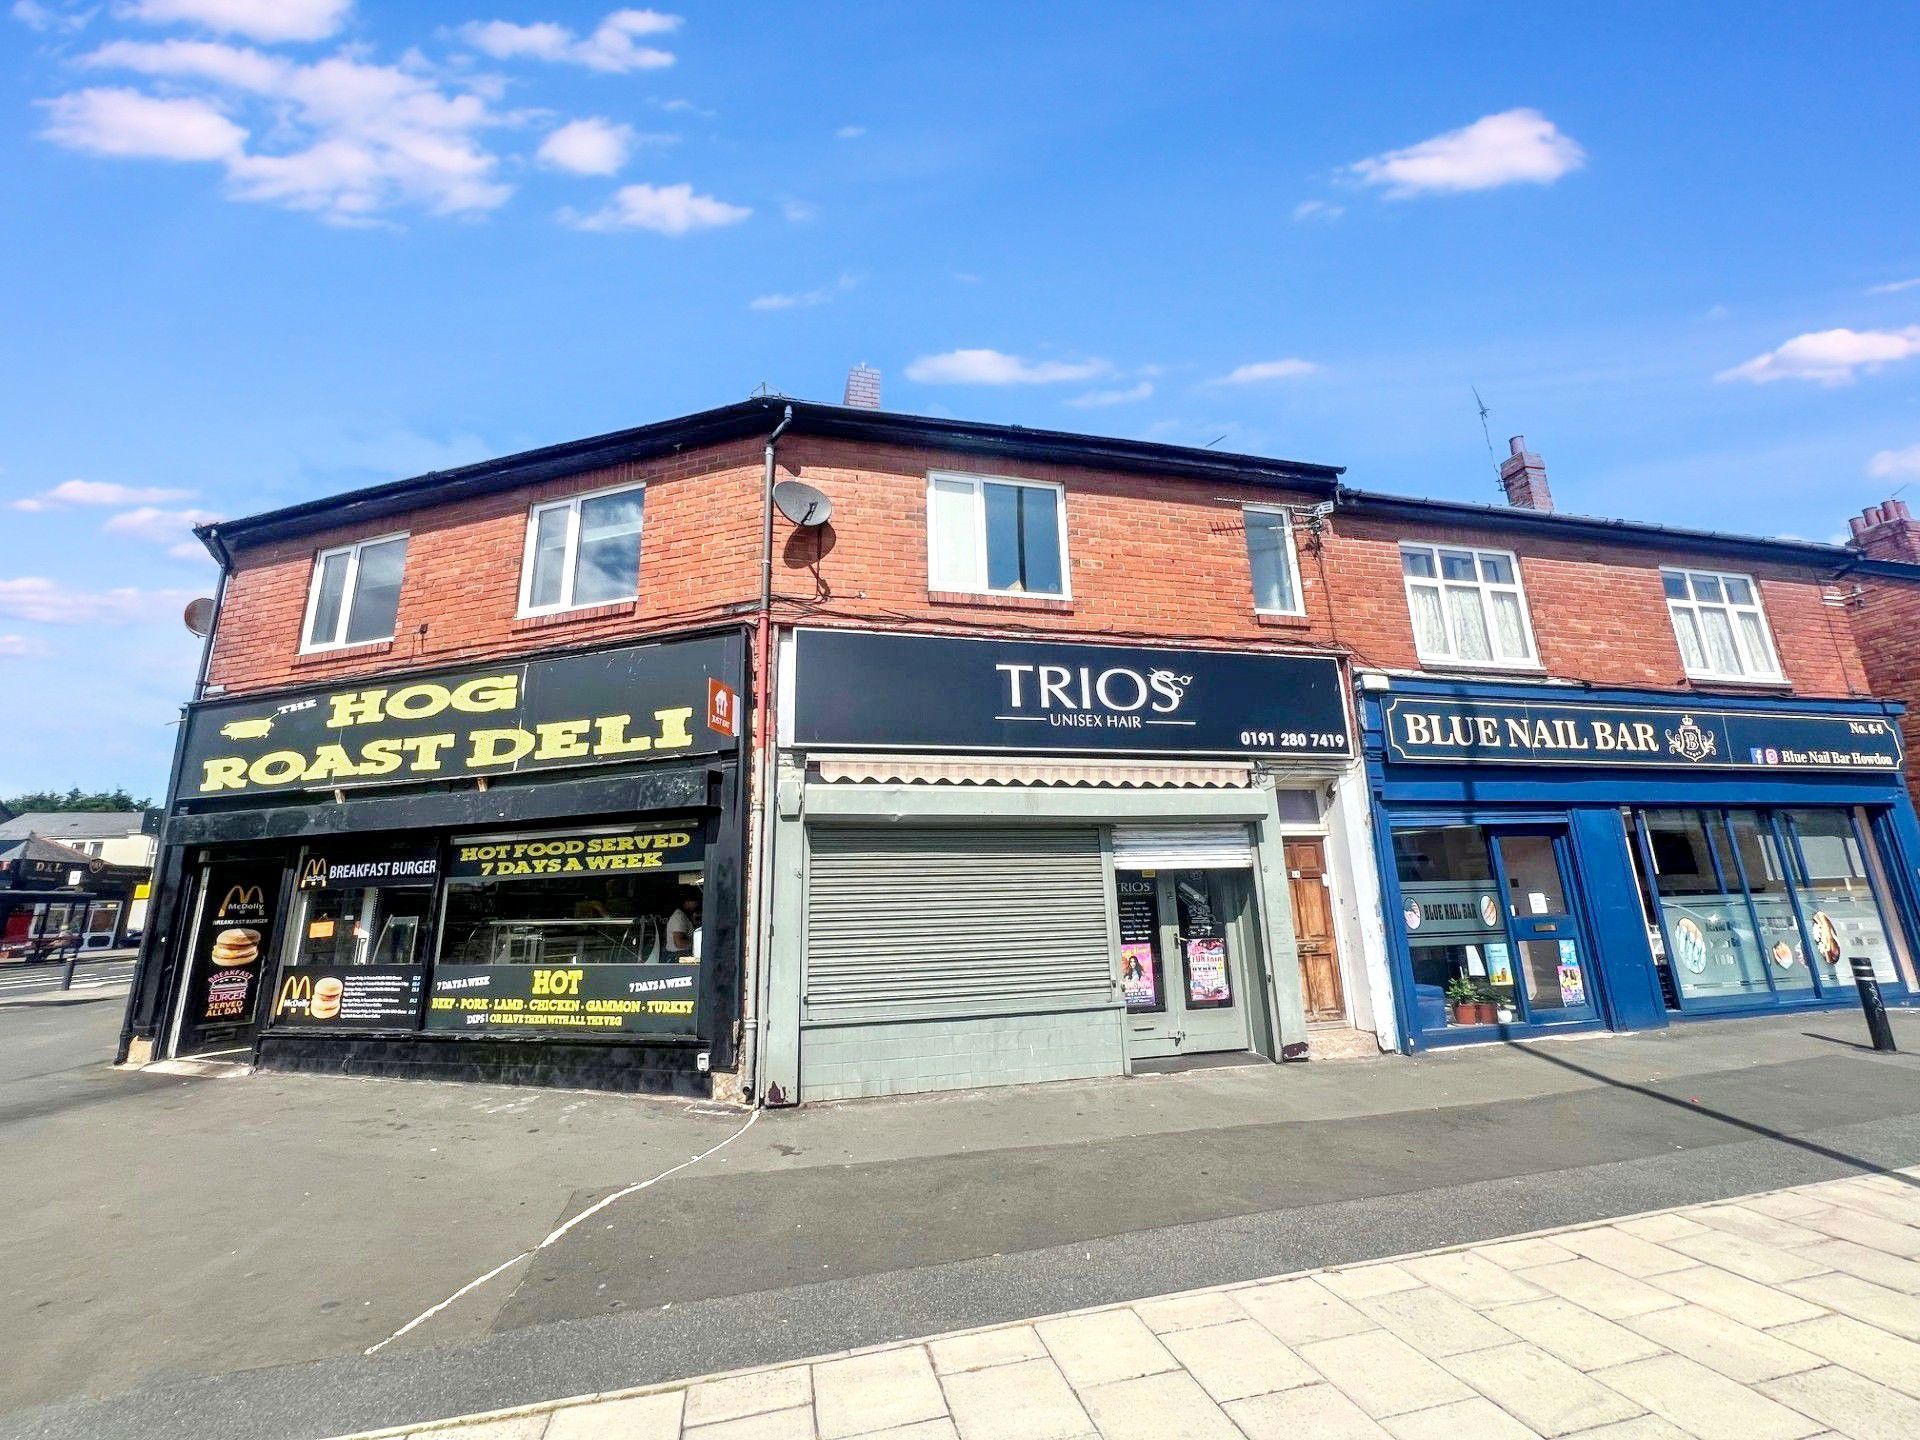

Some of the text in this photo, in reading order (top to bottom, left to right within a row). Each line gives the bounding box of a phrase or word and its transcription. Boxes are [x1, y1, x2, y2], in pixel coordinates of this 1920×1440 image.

[995, 663, 1186, 713] TRIOS
[277, 674, 519, 728] THE HOG
[1050, 713, 1142, 728] UNISEX HAIR
[1848, 722, 1868, 734] No.
[1240, 731, 1345, 748] 0191 280 7419
[1403, 713, 1660, 752] BLUE NAIL BAR
[200, 707, 695, 793] ROAST DELI
[1781, 750, 1893, 765] Blue Nail Bar Howdon
[459, 833, 690, 861] HOT FOOD SERVED
[329, 859, 437, 879] BREAKFAST BURGER
[481, 851, 663, 876] 7 DAYS A WEEK
[228, 902, 264, 910] McDolly
[1423, 904, 1444, 920] BLUE
[208, 970, 253, 984] BREAKFAST
[532, 970, 583, 995] HOT
[635, 980, 659, 992] DAYS
[666, 976, 693, 988] WEEK
[208, 991, 246, 1002] BURGER
[205, 1006, 244, 1017] ALL DAY
[208, 1001, 243, 1010] SERVED
[431, 998, 695, 1013] BEEF PORK LAMB CHICKEN GAMMON TURKEY
